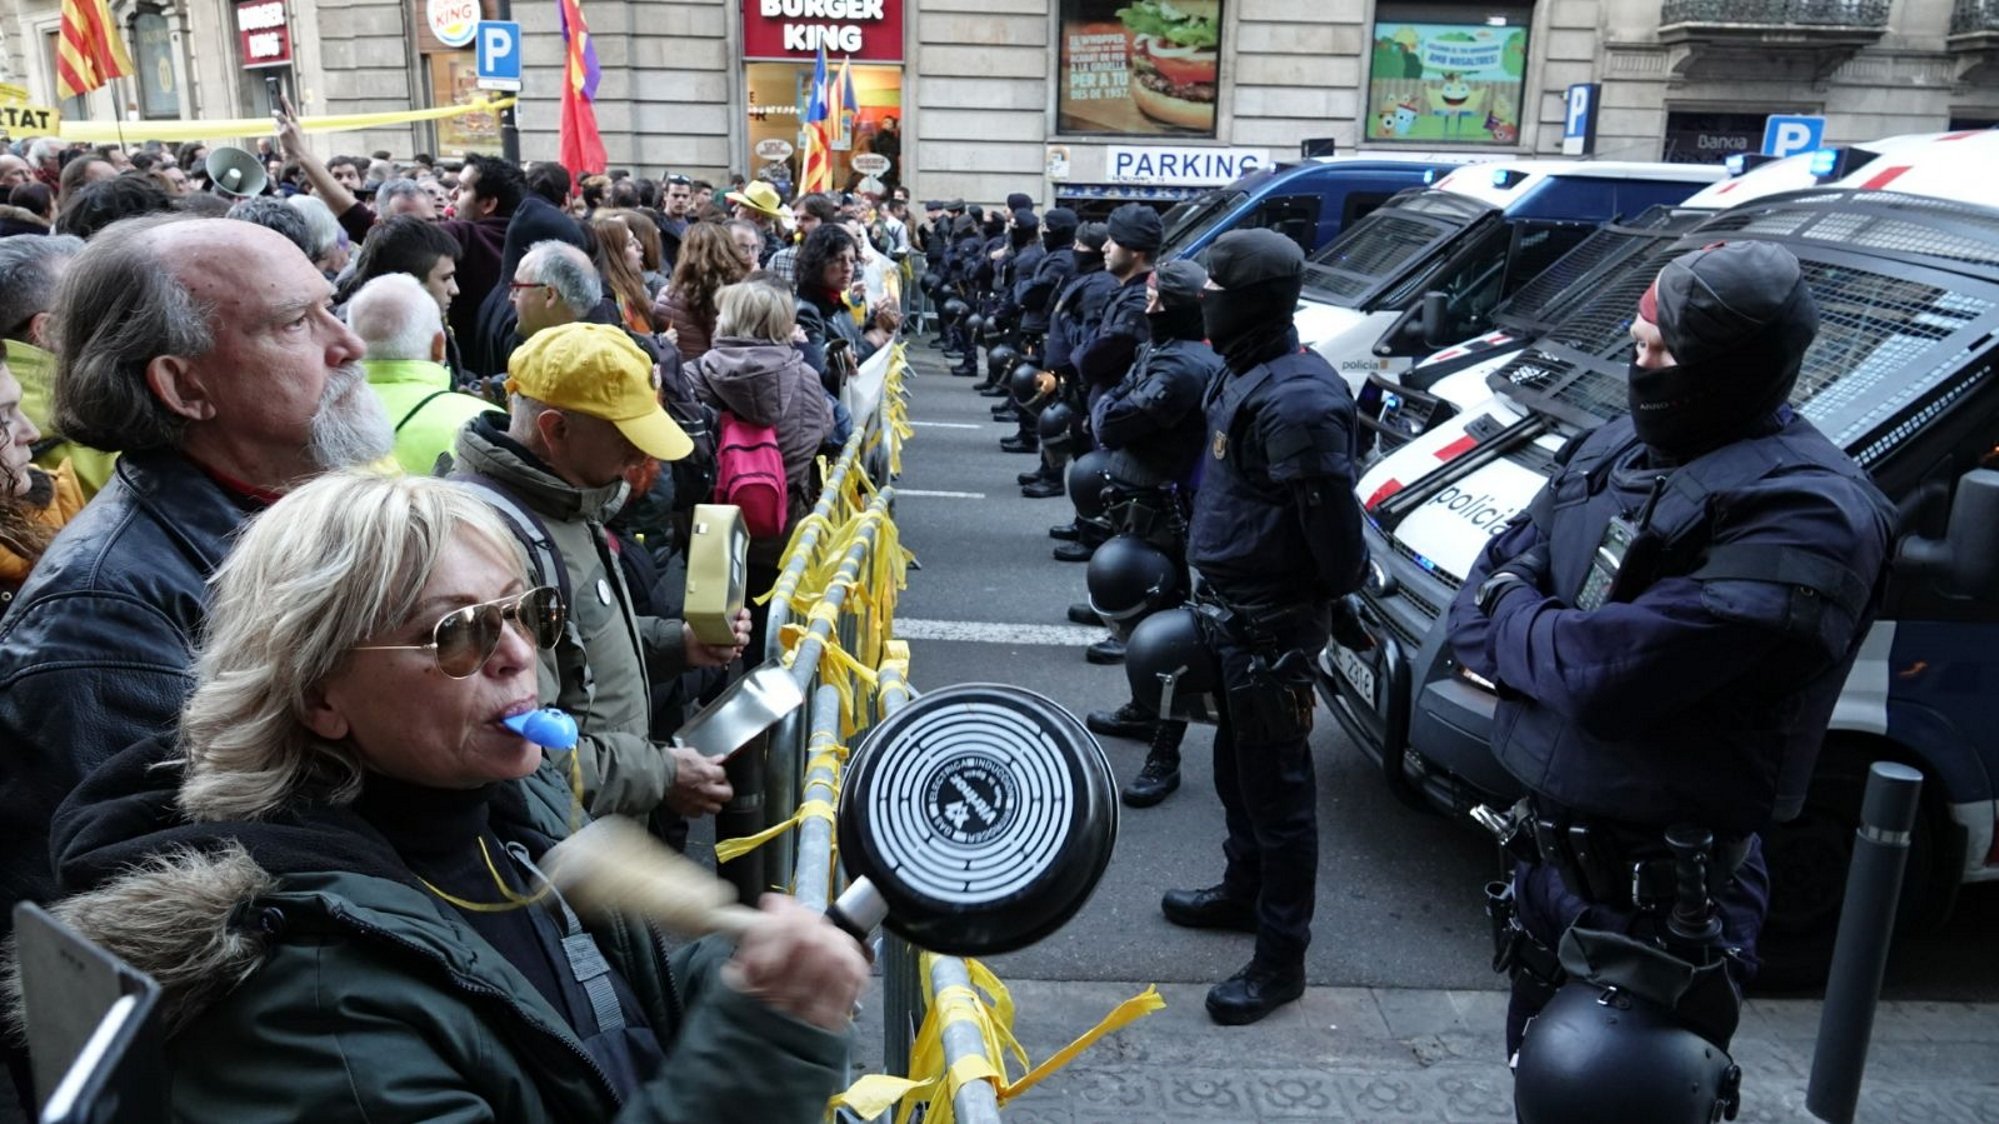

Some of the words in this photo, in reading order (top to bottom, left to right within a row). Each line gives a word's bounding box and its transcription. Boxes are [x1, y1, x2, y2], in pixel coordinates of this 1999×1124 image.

[436, 4, 472, 27] KING
[760, 0, 884, 20] BURGER
[783, 23, 862, 52] KING
[485, 28, 512, 72] P
[1071, 72, 1097, 87] PER
[1099, 71, 1110, 86] A
[1111, 70, 1129, 86] TU
[0, 107, 50, 129] TAT
[1569, 86, 1589, 134] P
[1697, 134, 1748, 150] Bankia
[1773, 122, 1811, 157] P
[1342, 359, 1379, 371] policia
[1427, 486, 1513, 535] policia
